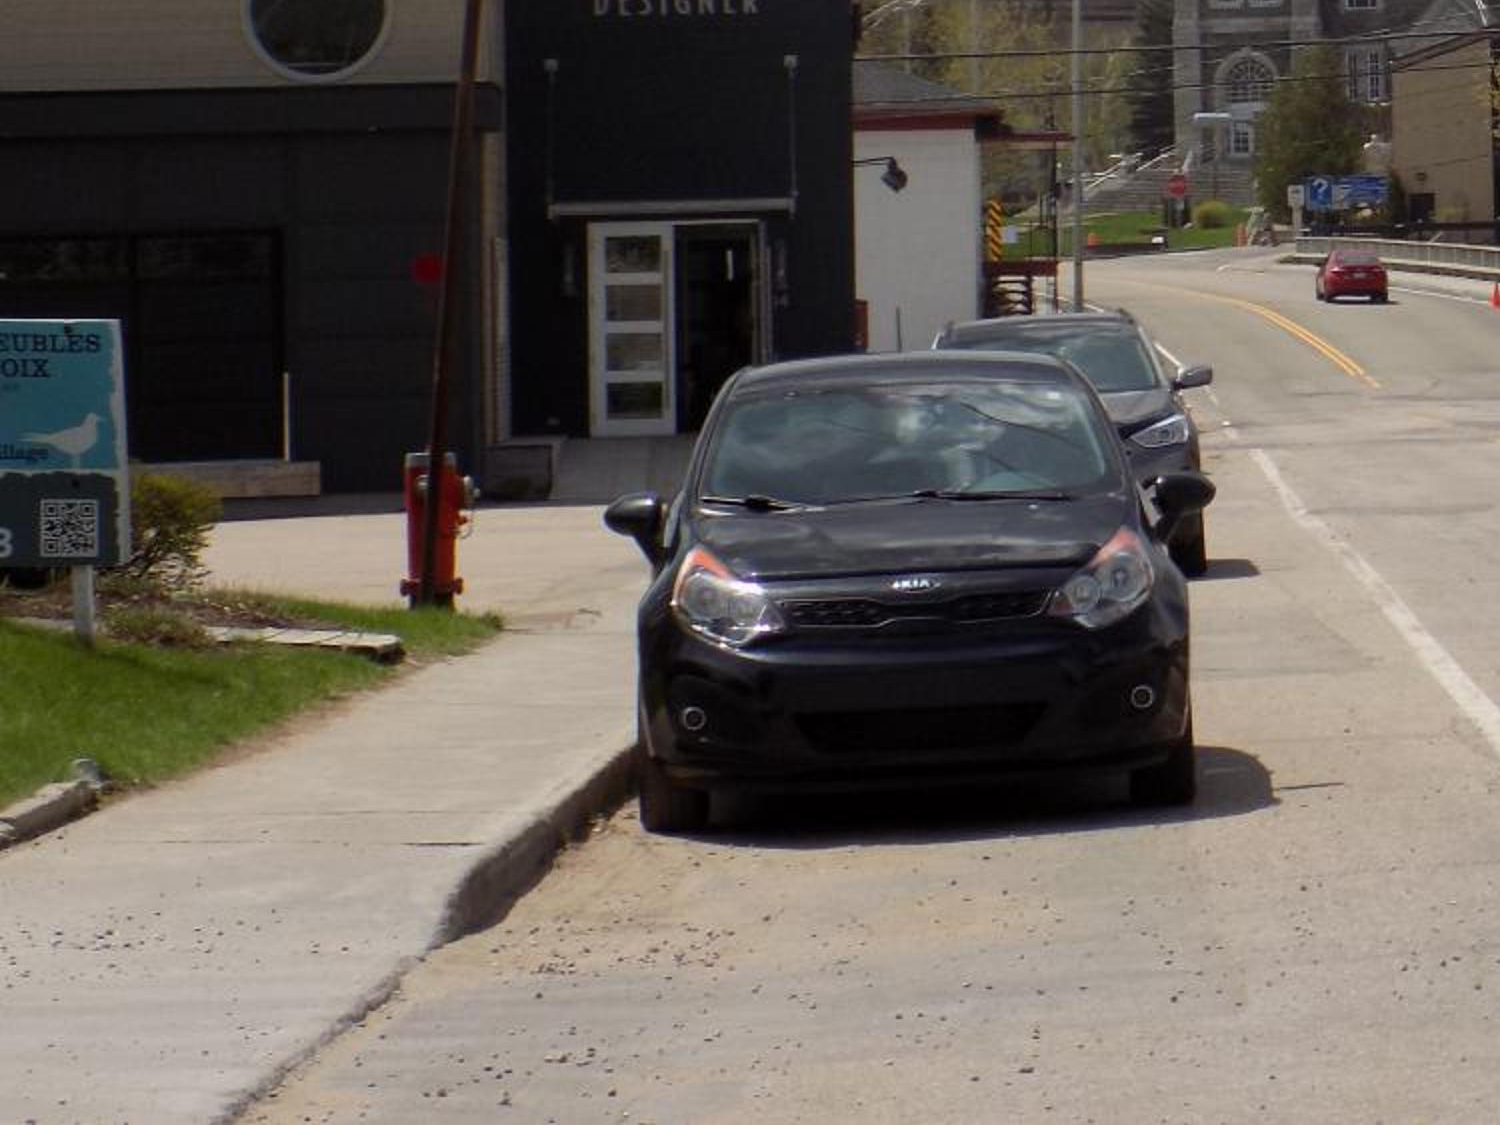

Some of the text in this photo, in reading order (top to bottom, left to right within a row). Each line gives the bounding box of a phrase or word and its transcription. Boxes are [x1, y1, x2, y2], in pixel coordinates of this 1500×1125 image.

[0, 333, 101, 354] EUBLES
[0, 358, 49, 378] OIX
[901, 578, 930, 588] KIA
